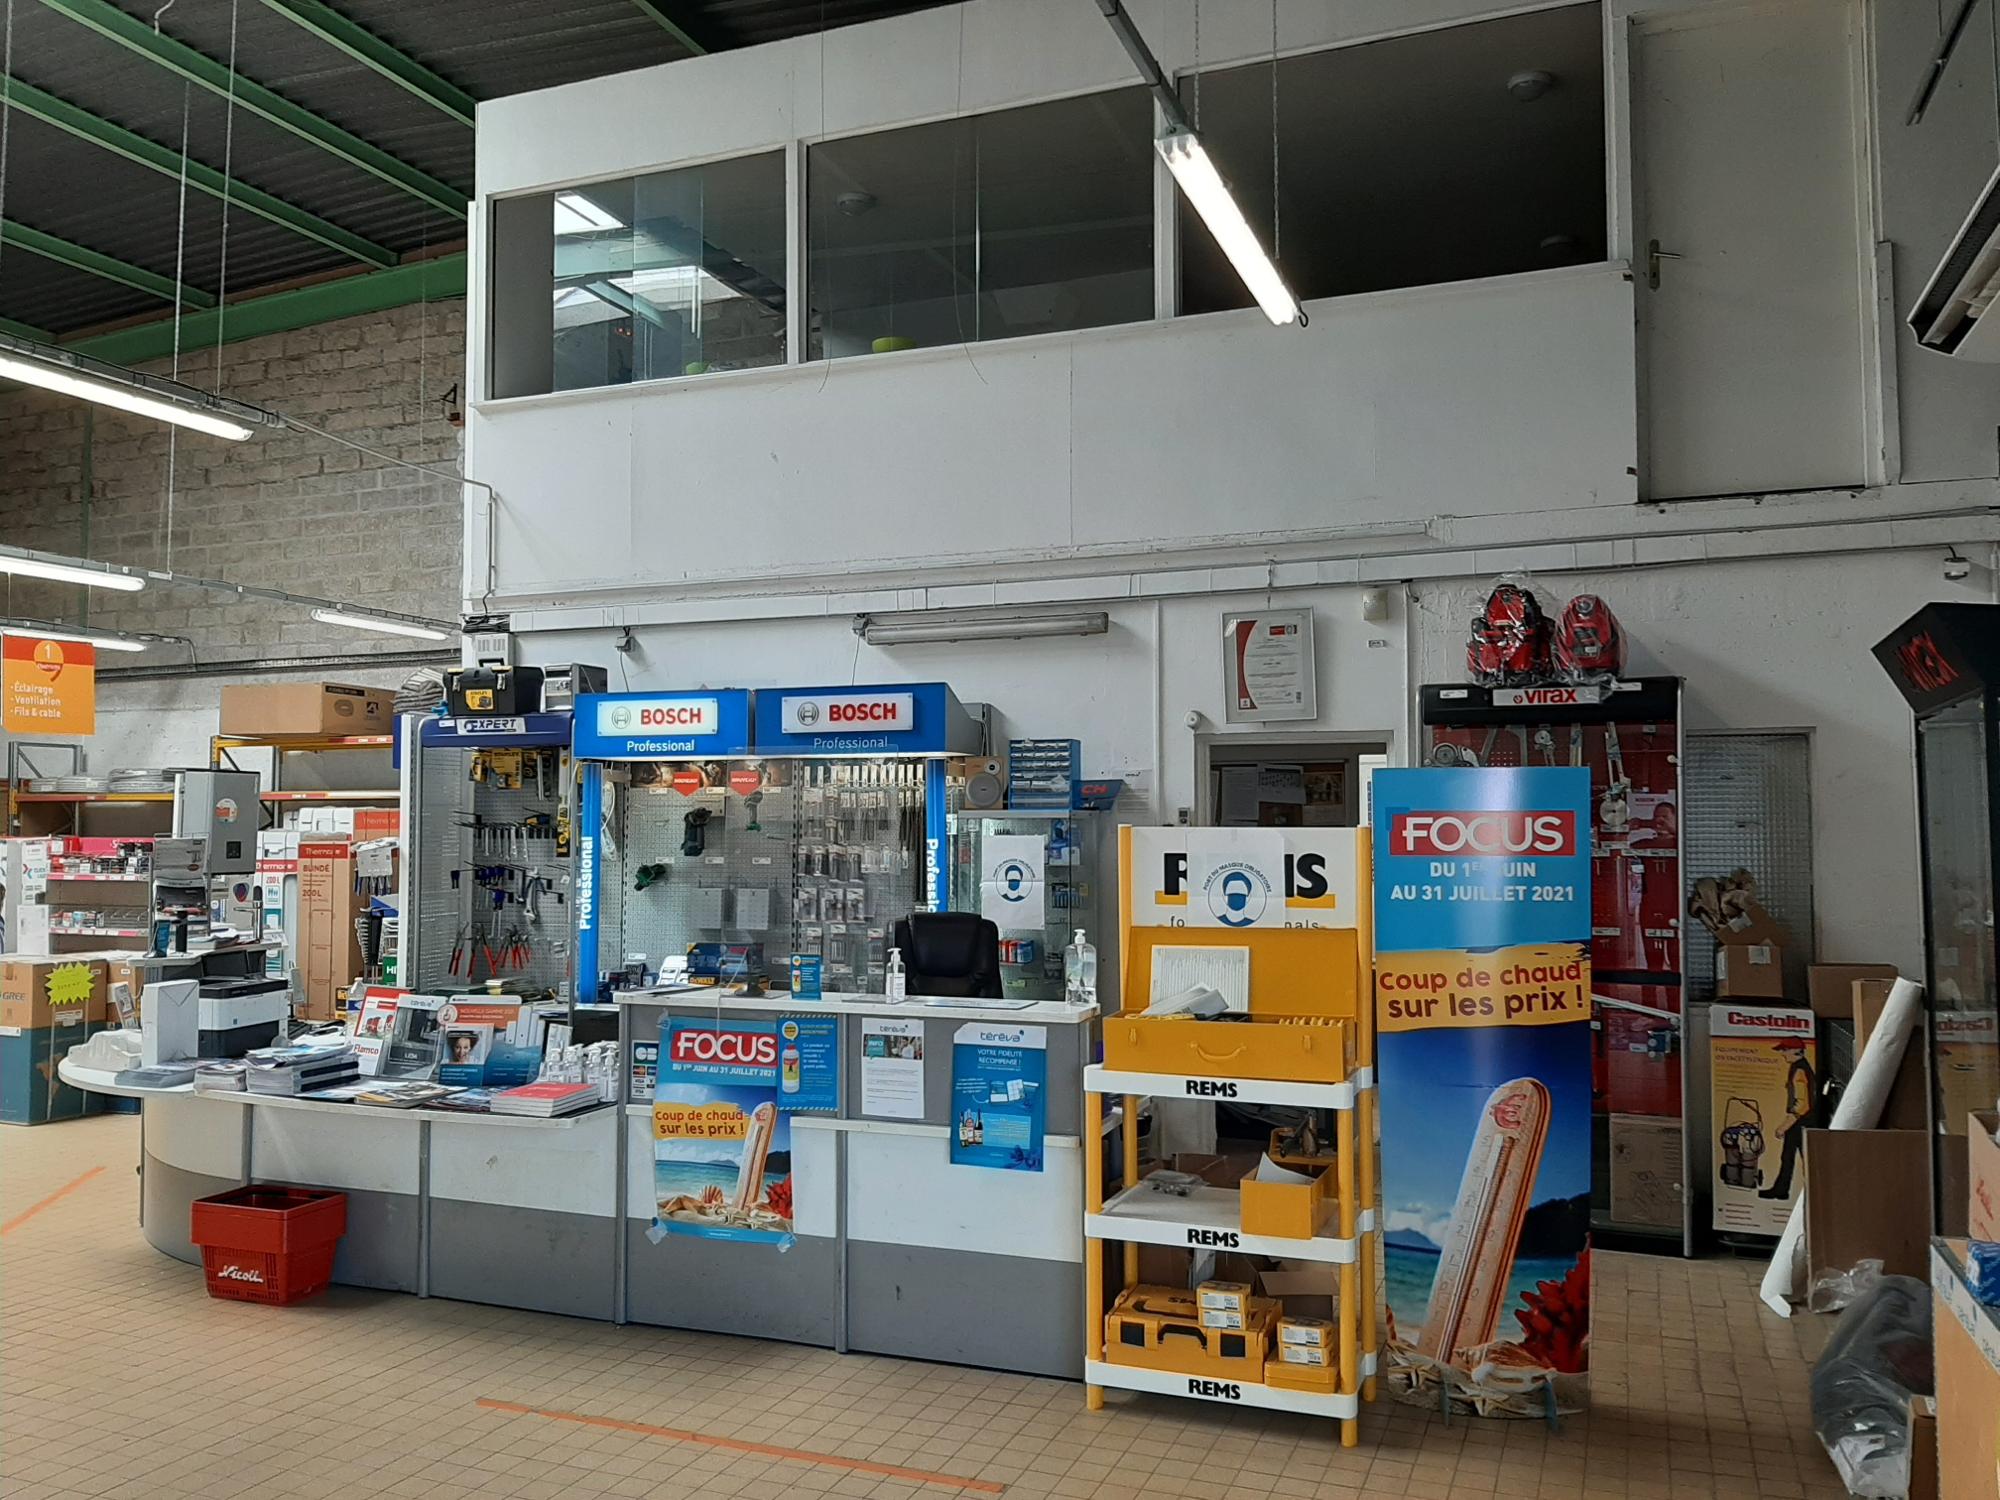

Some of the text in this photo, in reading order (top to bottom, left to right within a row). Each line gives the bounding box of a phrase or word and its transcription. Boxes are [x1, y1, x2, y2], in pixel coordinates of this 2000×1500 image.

[45, 644, 51, 659] 1
[14, 680, 53, 695] Éclairage
[14, 695, 62, 706] Ventilation
[14, 706, 30, 715] Fils
[640, 708, 701, 725] BOSCH
[829, 703, 896, 722] BOSCH
[627, 740, 695, 753] Professional
[814, 736, 888, 750] Professional
[1402, 816, 1564, 852] FOCUS
[926, 838, 940, 913] Professio
[1430, 862, 1537, 877] DU 1E UIN
[580, 836, 593, 930] Professional
[1390, 885, 1416, 900] AU
[1422, 885, 1442, 900] 31
[1532, 886, 1574, 901] 2021
[1456, 967, 1491, 988] de
[1500, 960, 1582, 985] chaud
[1388, 984, 1584, 1019] sur les prix !
[1728, 1011, 1810, 1028] Castolin
[354, 1044, 379, 1055] Flamco
[677, 1032, 776, 1063] FOCUS
[719, 1066, 728, 1074] 31
[729, 1067, 758, 1076] JUILLET
[760, 1069, 776, 1077] 2021
[1186, 1080, 1238, 1098] REMS
[690, 1110, 703, 1121] de
[706, 1110, 744, 1121] chaud
[660, 1122, 745, 1137] sur les prix !
[1187, 1228, 1239, 1248] REMS
[218, 1265, 264, 1283] Nicoll
[1188, 1378, 1241, 1400] REMS
